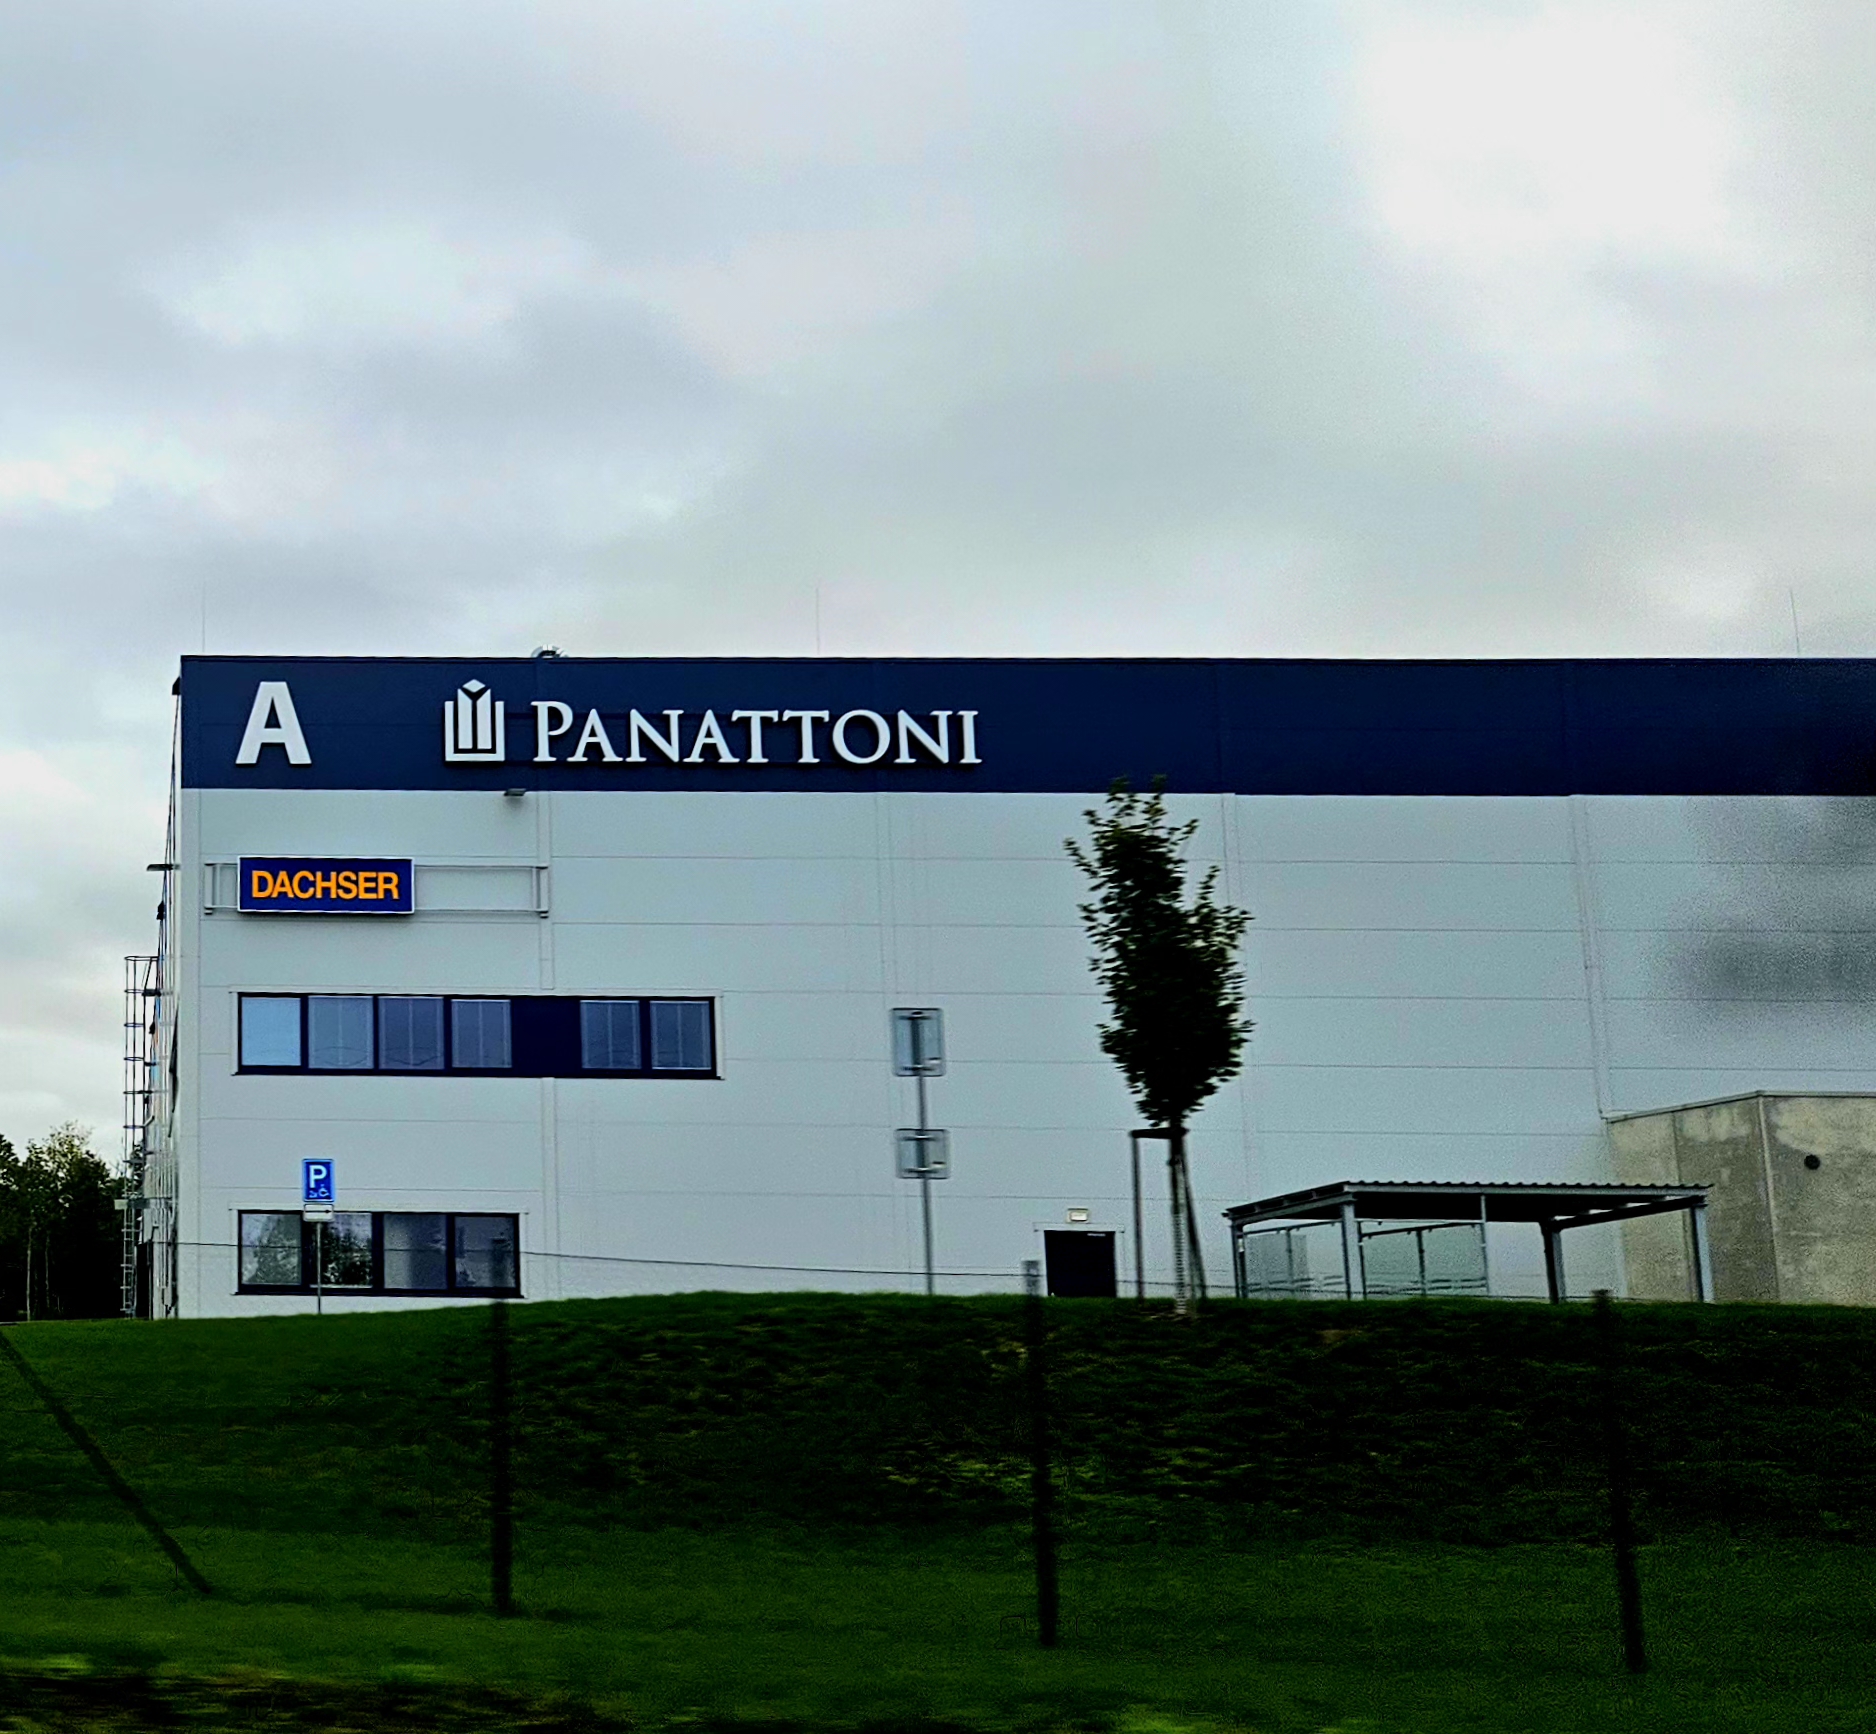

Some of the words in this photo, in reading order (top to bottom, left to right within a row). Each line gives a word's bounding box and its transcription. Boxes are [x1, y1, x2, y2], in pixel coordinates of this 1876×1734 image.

[235, 681, 312, 764] A
[531, 701, 982, 764] PANATTONI
[251, 870, 399, 900] DACHSER
[309, 1165, 327, 1188] P
